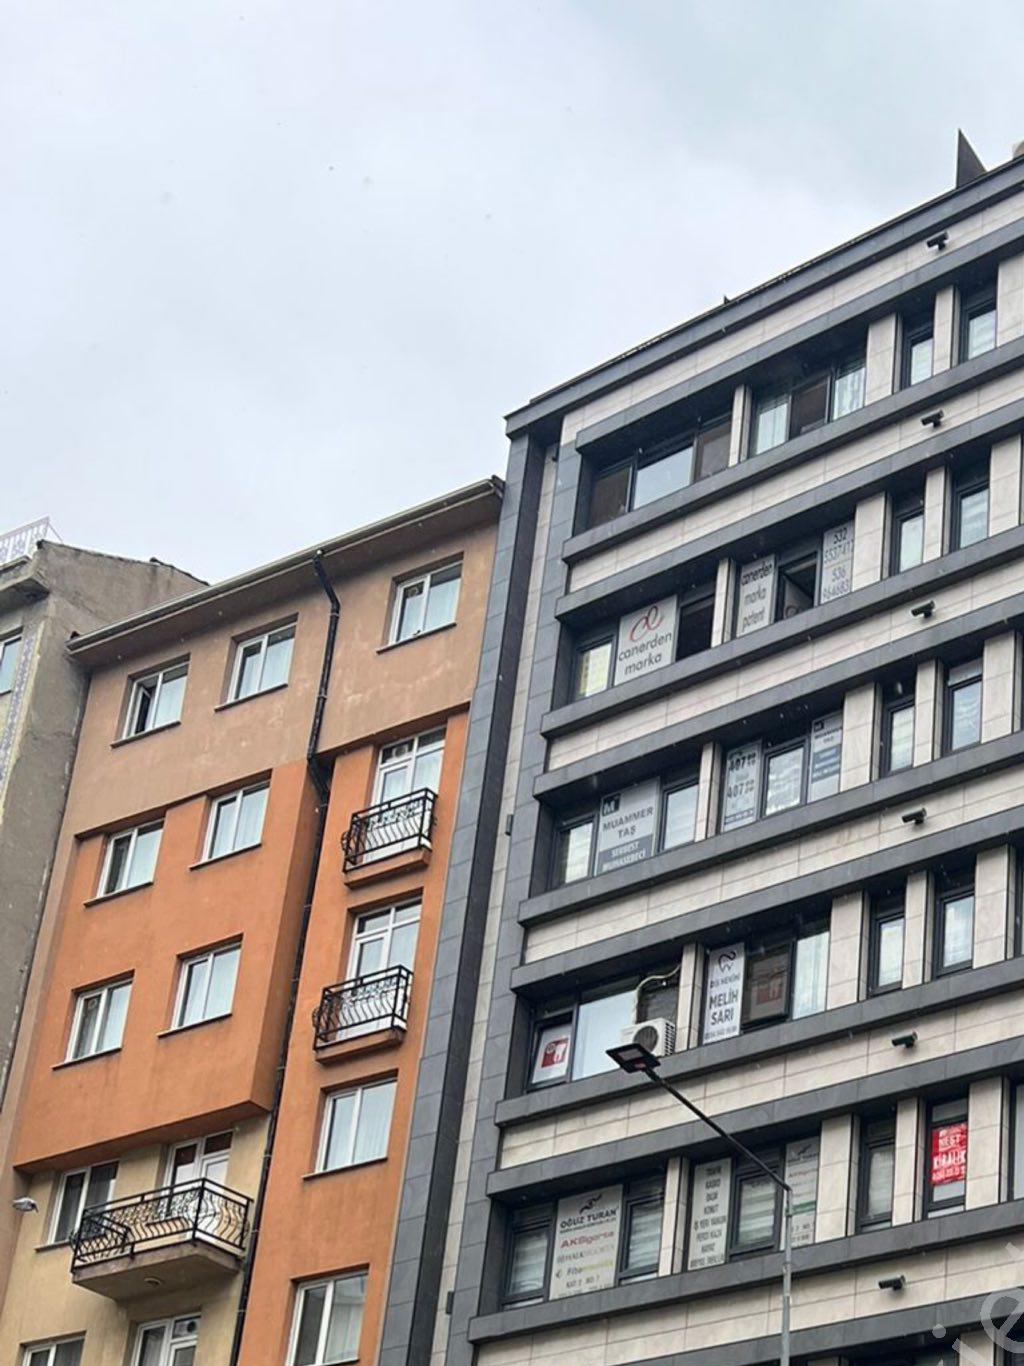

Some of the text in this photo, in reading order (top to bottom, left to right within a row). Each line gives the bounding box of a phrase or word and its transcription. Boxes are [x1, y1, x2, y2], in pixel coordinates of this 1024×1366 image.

[618, 632, 672, 662] canerden
[624, 653, 662, 675] marka
[602, 806, 655, 832] MUAMMER
[709, 988, 739, 1011] MELİH
[711, 1007, 735, 1026] SARI
